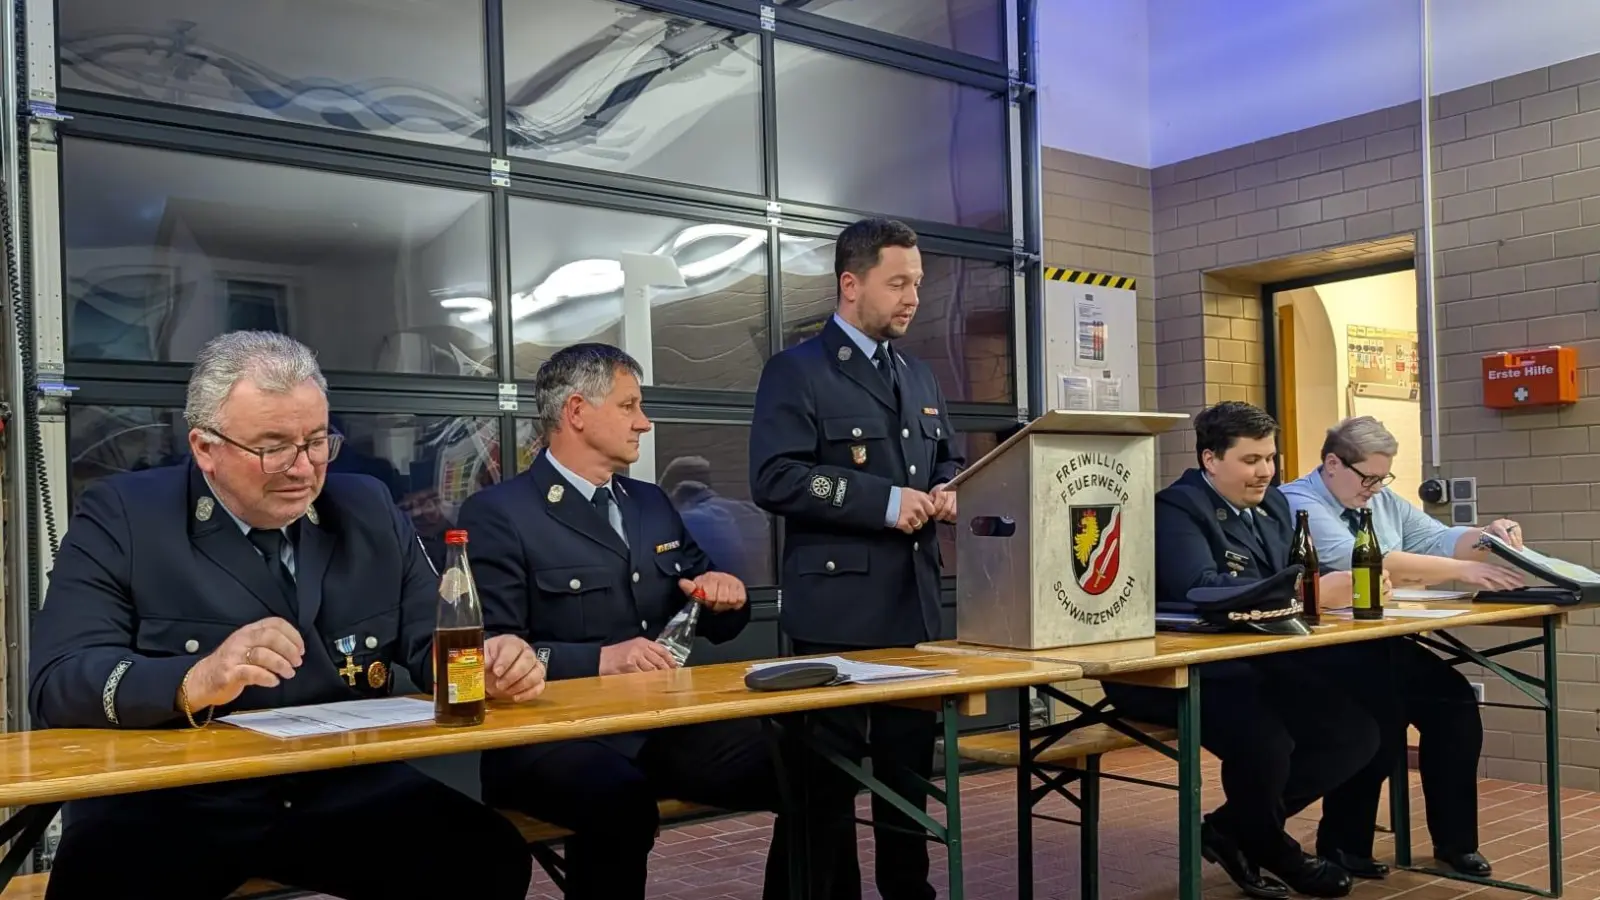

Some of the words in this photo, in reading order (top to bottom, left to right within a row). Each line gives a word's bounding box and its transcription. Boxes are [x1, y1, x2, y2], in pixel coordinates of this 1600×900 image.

[1488, 369, 1521, 380] Erste
[1524, 365, 1554, 377] Hilfe
[1055, 452, 1131, 484] FREIWILLIGE
[1060, 474, 1129, 505] FEUERWEHR
[1053, 575, 1135, 626] SCHWARZENBACH
